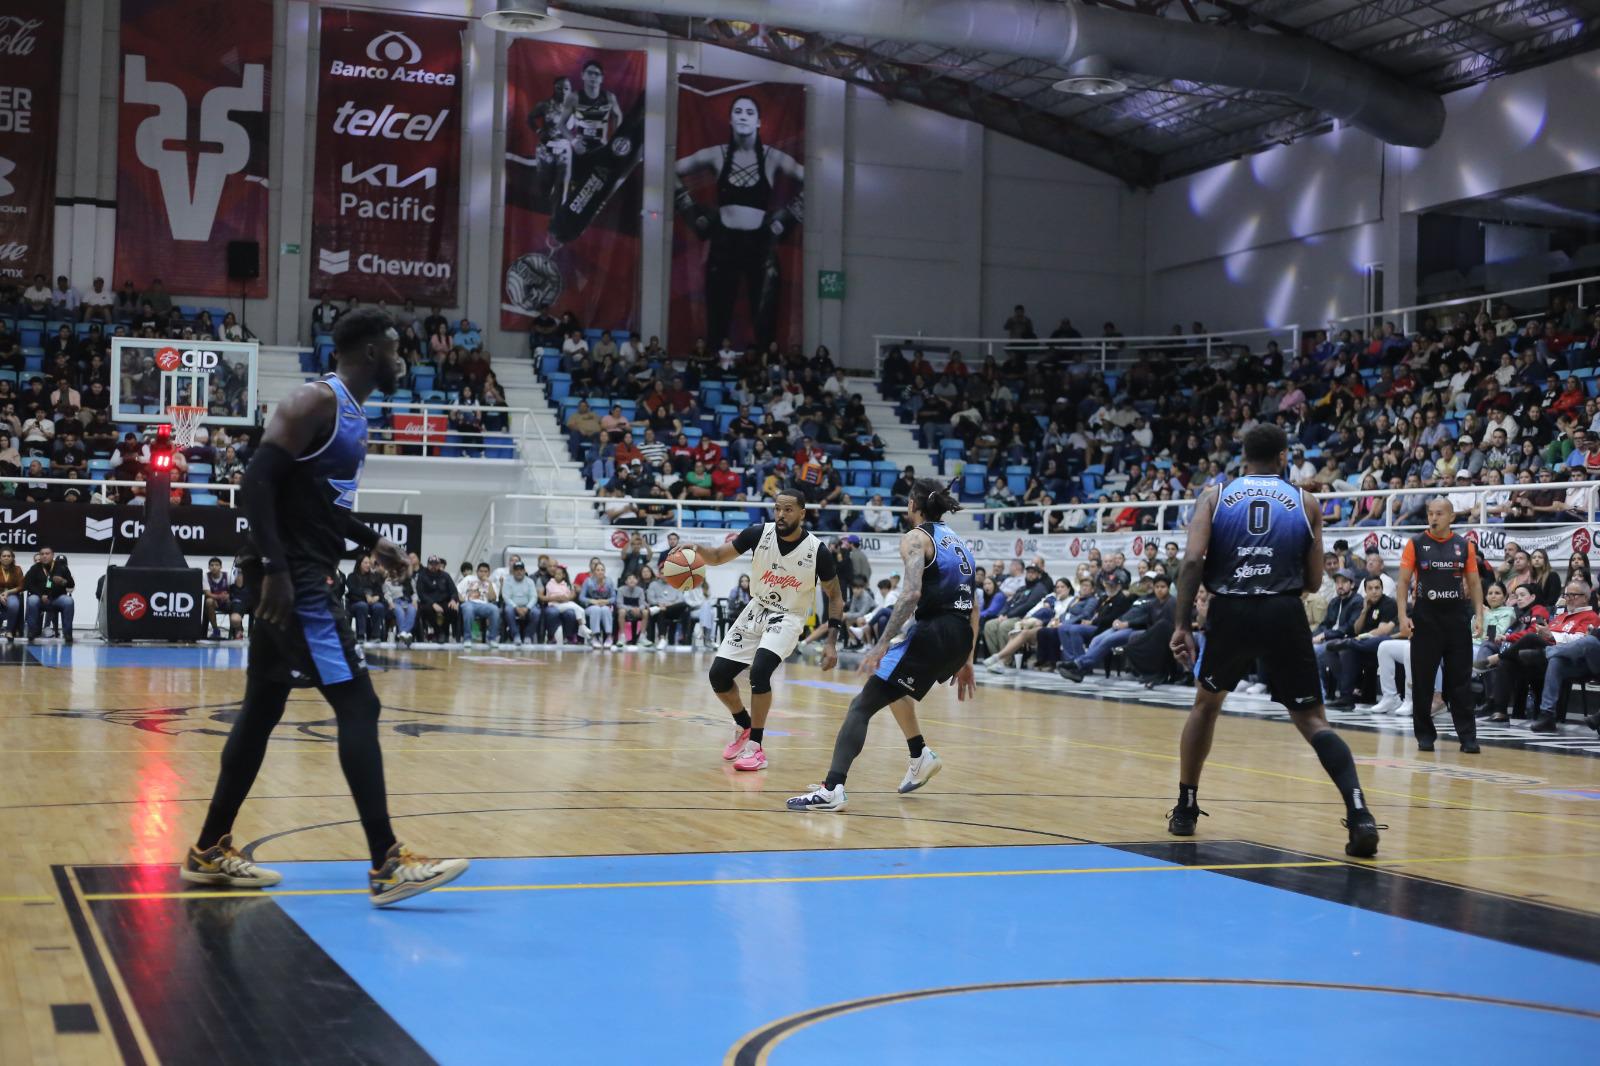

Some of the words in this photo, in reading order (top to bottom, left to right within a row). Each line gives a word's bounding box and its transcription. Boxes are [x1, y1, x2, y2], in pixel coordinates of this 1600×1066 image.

[330, 60, 388, 79] Banco
[391, 66, 456, 85] Azteca
[333, 101, 449, 141] telcel
[342, 161, 437, 190] KIA
[340, 193, 435, 222] Pacific
[357, 253, 450, 278] Chevron
[181, 350, 218, 368] CID
[120, 520, 205, 540] Chron
[1247, 500, 1271, 535] 0
[954, 546, 972, 575] 3
[150, 592, 194, 612] CID
[1437, 591, 1459, 599] MEGA
